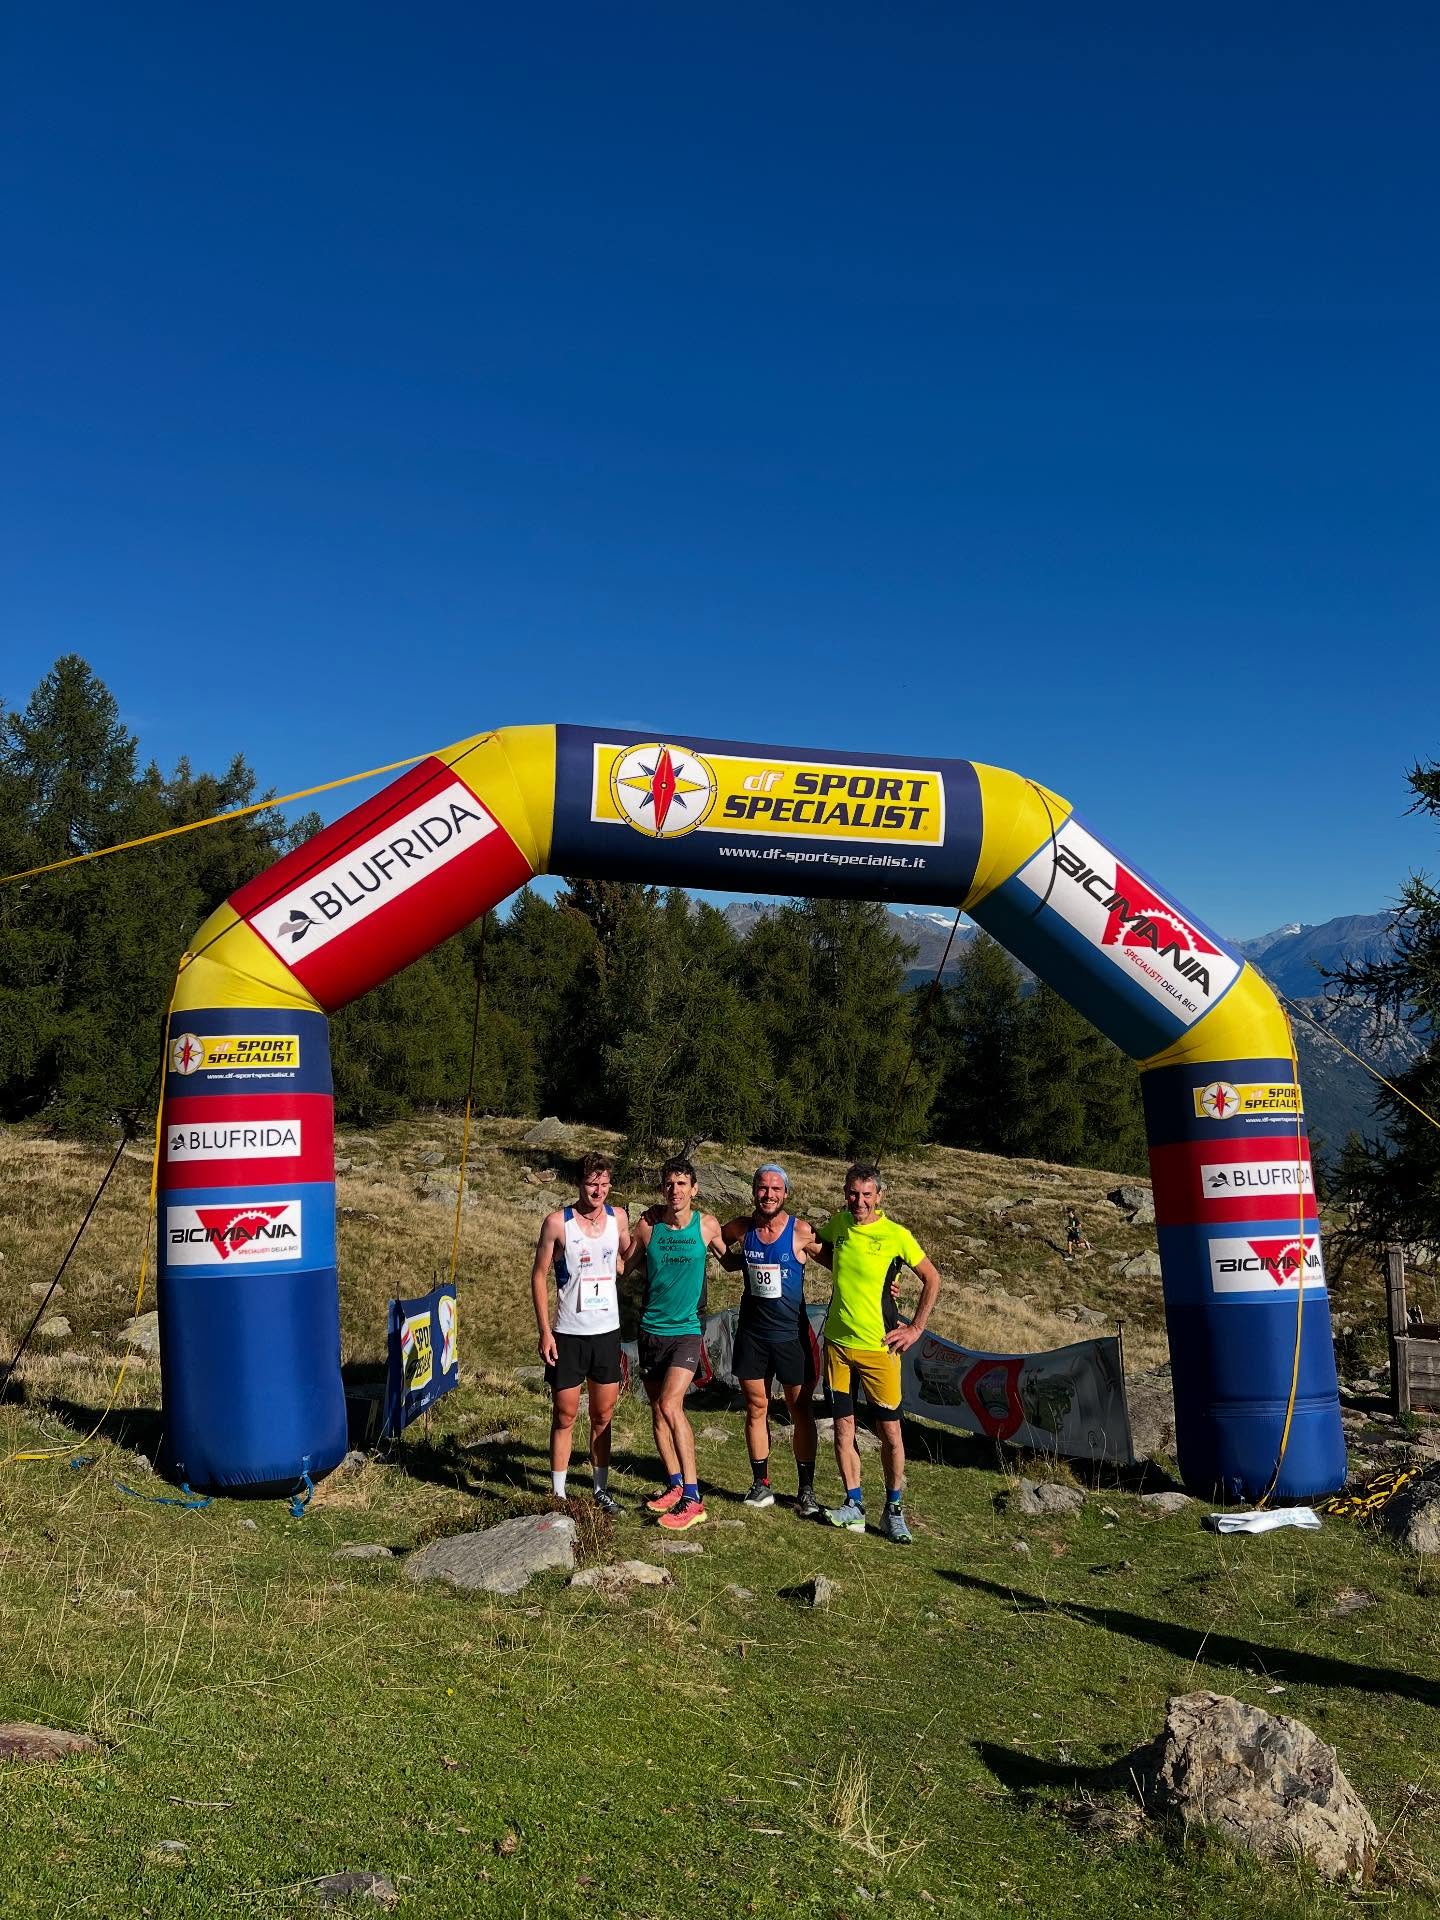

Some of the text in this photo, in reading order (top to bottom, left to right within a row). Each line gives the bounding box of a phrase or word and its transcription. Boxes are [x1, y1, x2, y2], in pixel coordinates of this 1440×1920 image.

[743, 769, 930, 802] df SPORT
[722, 795, 930, 831] SPECIALIST
[309, 803, 482, 921] BLUFRIDA
[718, 847, 927, 870] www.df-sportspecialist.it
[1052, 844, 1210, 997] BICIMANIA
[1123, 947, 1198, 1014] SPECIALISTI DELLA BICI
[236, 1040, 294, 1052] SPORT
[207, 1052, 294, 1064] SPECIALIST
[189, 1128, 297, 1150] BLUFRIDA
[1233, 1168, 1311, 1187] BLUFRIDA
[169, 1223, 298, 1244] BICIMANIA
[1215, 1254, 1321, 1273] BICIMANIA
[756, 1271, 771, 1285] 98
[593, 1282, 599, 1297] 1
